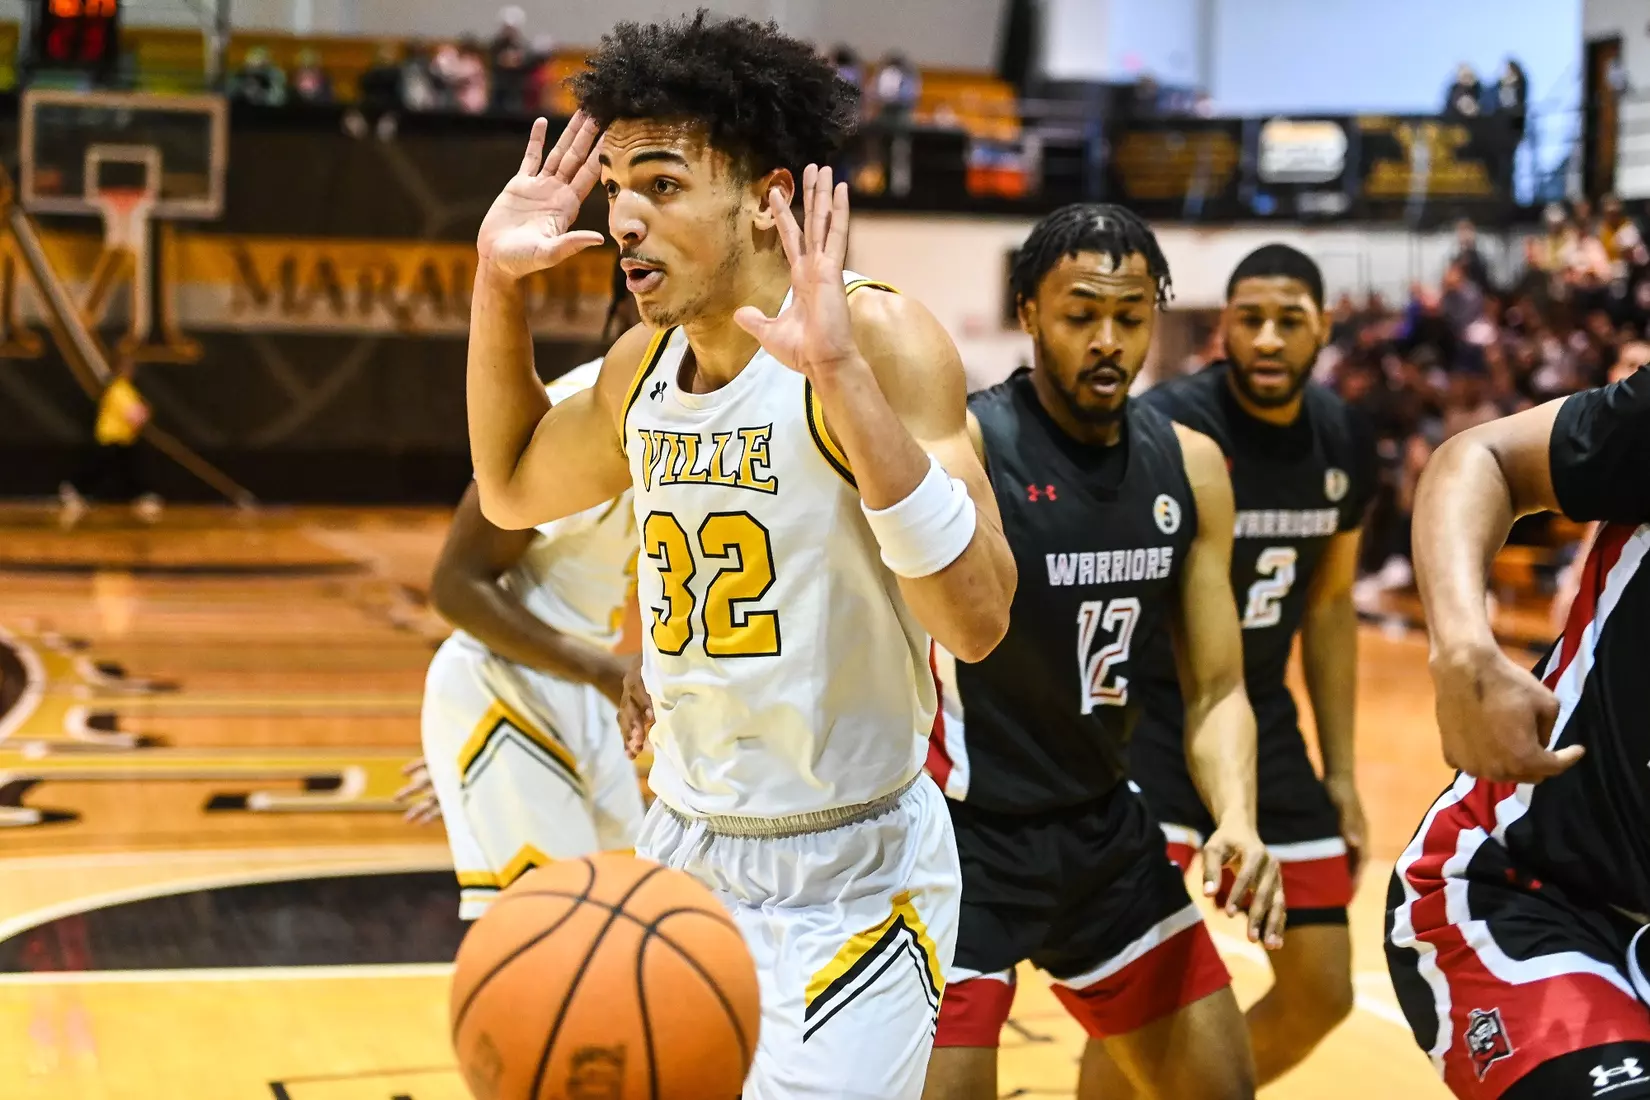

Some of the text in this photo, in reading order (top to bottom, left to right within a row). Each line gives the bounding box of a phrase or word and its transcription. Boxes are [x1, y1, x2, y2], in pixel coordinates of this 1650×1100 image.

[638, 422, 778, 495] VILLE
[644, 510, 782, 658] 32
[1045, 546, 1174, 586] WARRIORS
[1243, 546, 1299, 629] 2
[1077, 597, 1141, 715] 12
